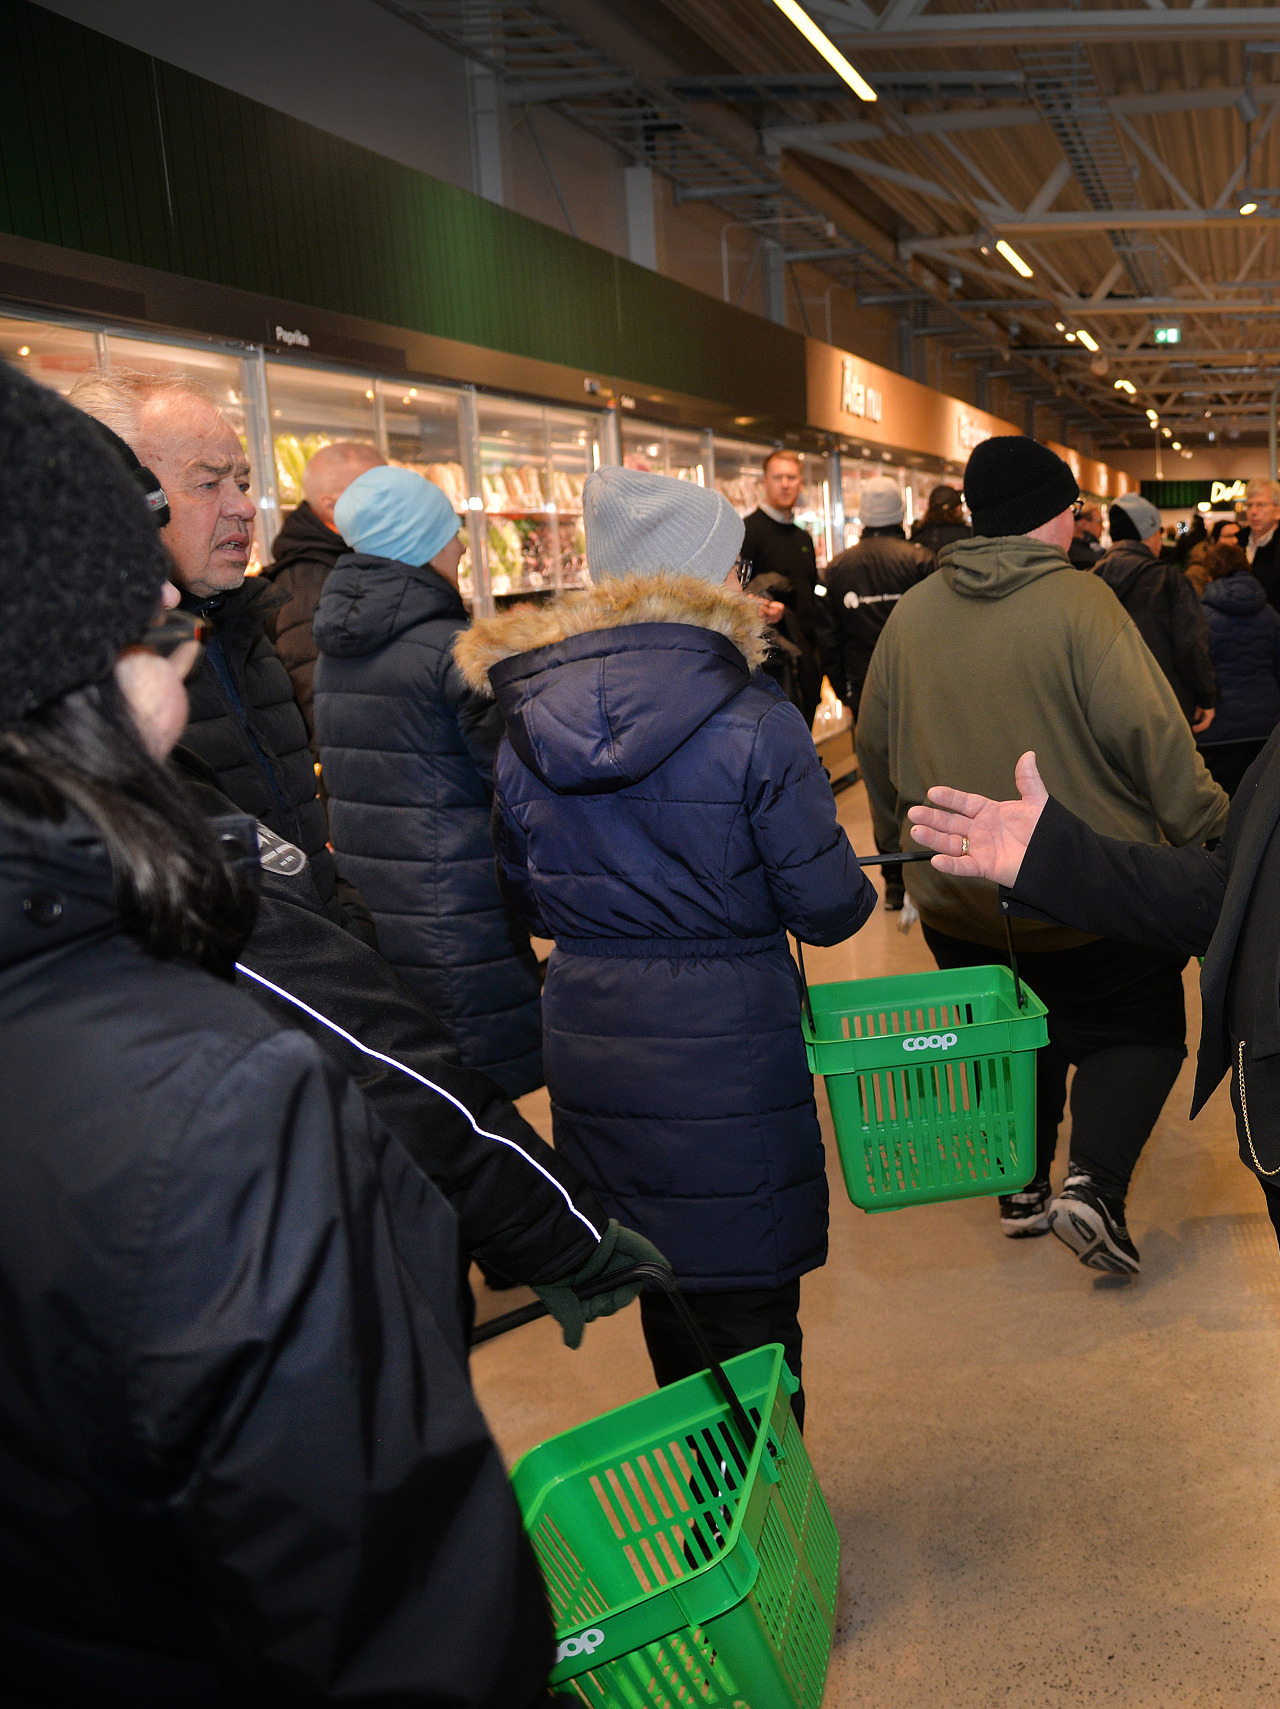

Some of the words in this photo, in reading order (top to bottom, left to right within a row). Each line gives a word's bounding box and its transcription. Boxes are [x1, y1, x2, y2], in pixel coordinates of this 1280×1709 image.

[275, 325, 311, 347] Paprika
[902, 1033, 957, 1052] coop
[555, 1628, 605, 1664] op
